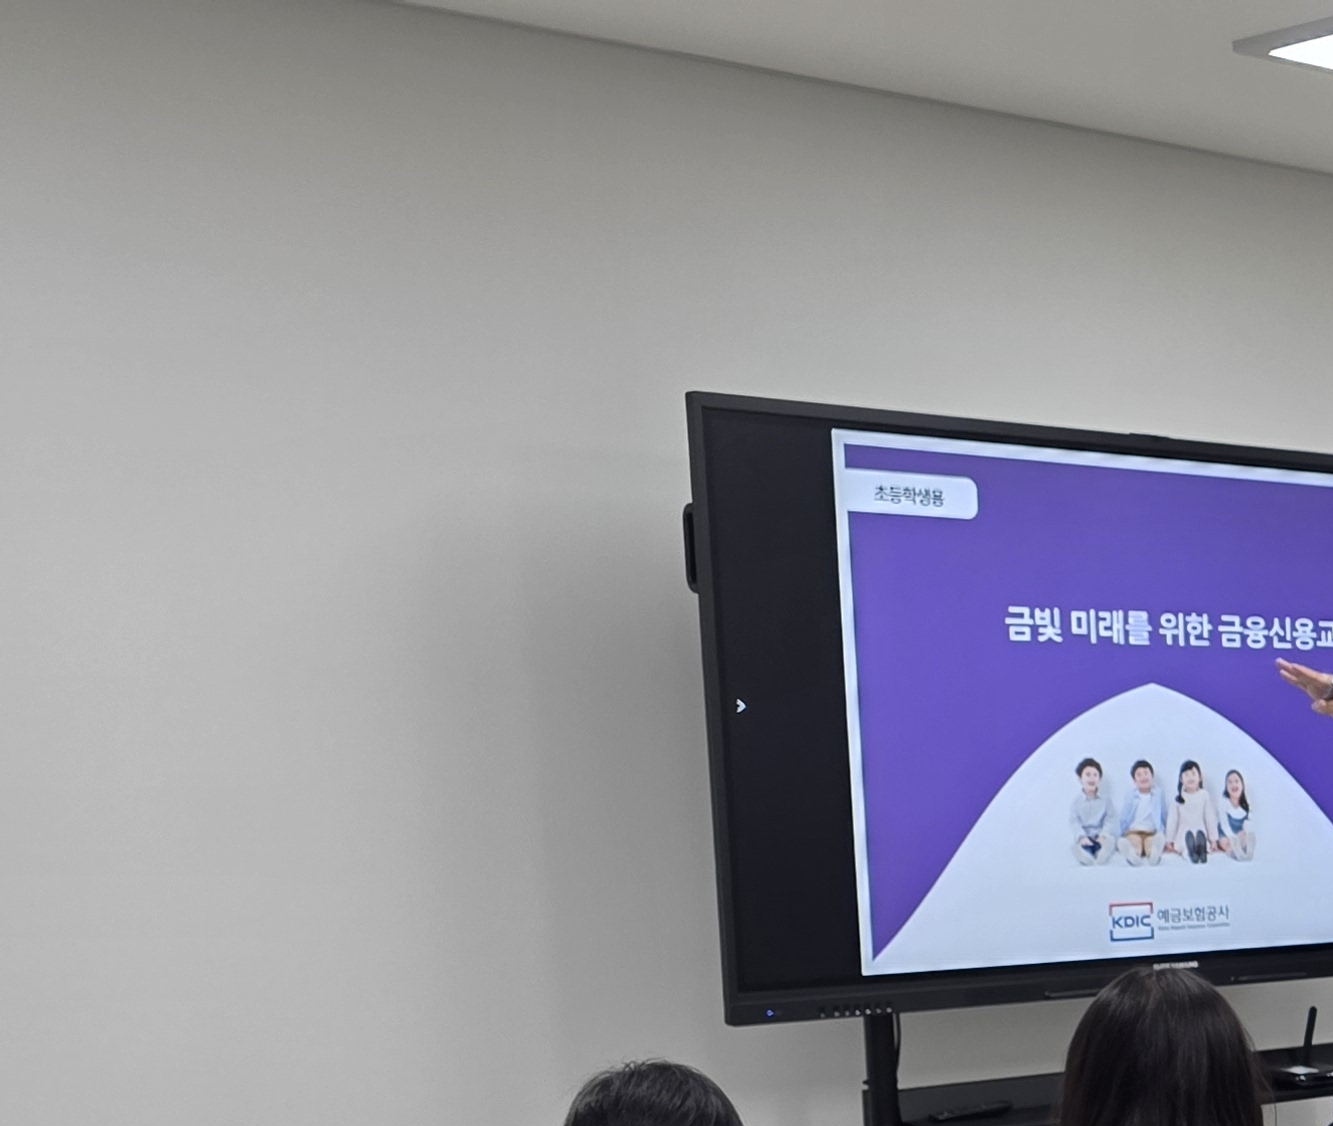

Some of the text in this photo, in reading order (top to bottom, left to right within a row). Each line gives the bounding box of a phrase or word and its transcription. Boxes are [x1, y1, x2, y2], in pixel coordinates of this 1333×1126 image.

[874, 484, 945, 507] 초등학생용
[1005, 606, 1063, 643] 금빛
[1070, 609, 1152, 646] 미래를
[1159, 612, 1212, 647] 위한
[1111, 914, 1152, 929] KDIC
[1157, 904, 1230, 924] 예금보험공사
